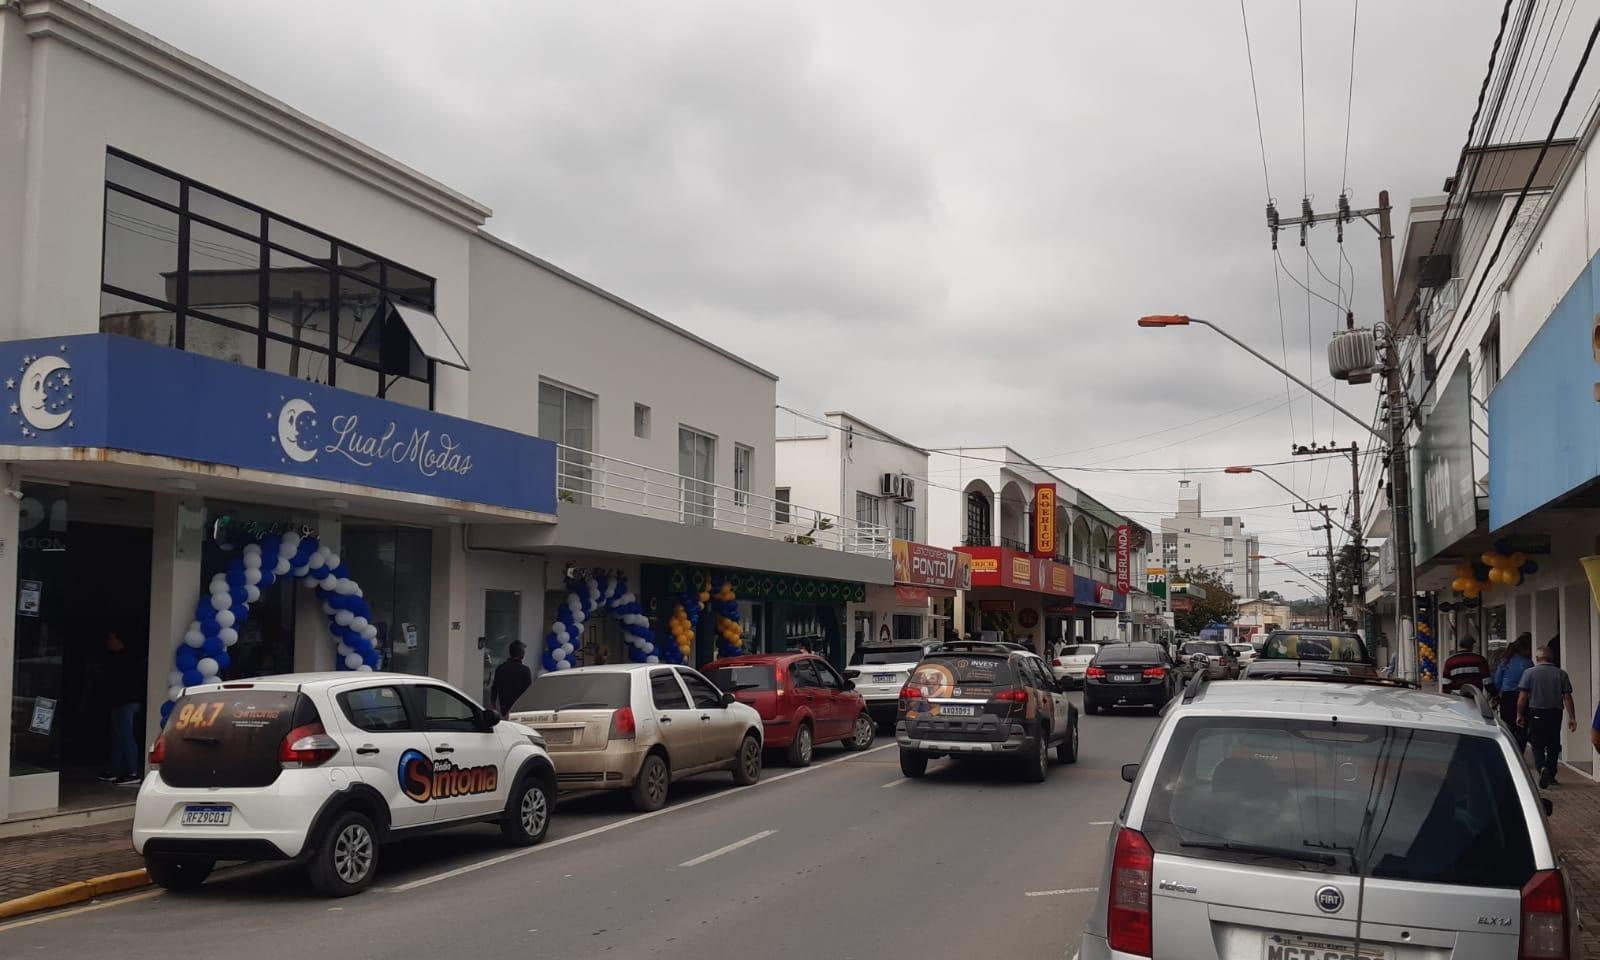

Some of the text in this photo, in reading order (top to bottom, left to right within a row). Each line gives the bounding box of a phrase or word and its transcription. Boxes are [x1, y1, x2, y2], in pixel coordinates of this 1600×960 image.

[325, 415, 473, 477] Lual Modas
[1040, 492, 1051, 548] KOERICH
[1118, 528, 1128, 580] BERLANDA
[912, 556, 947, 578] PONTO
[1147, 574, 1165, 583] BR
[970, 660, 999, 668] INVEST
[175, 702, 225, 730] 94.7
[403, 760, 497, 803] Sintonia
[1320, 893, 1340, 905] FIAT
[1478, 916, 1497, 926] ELX
